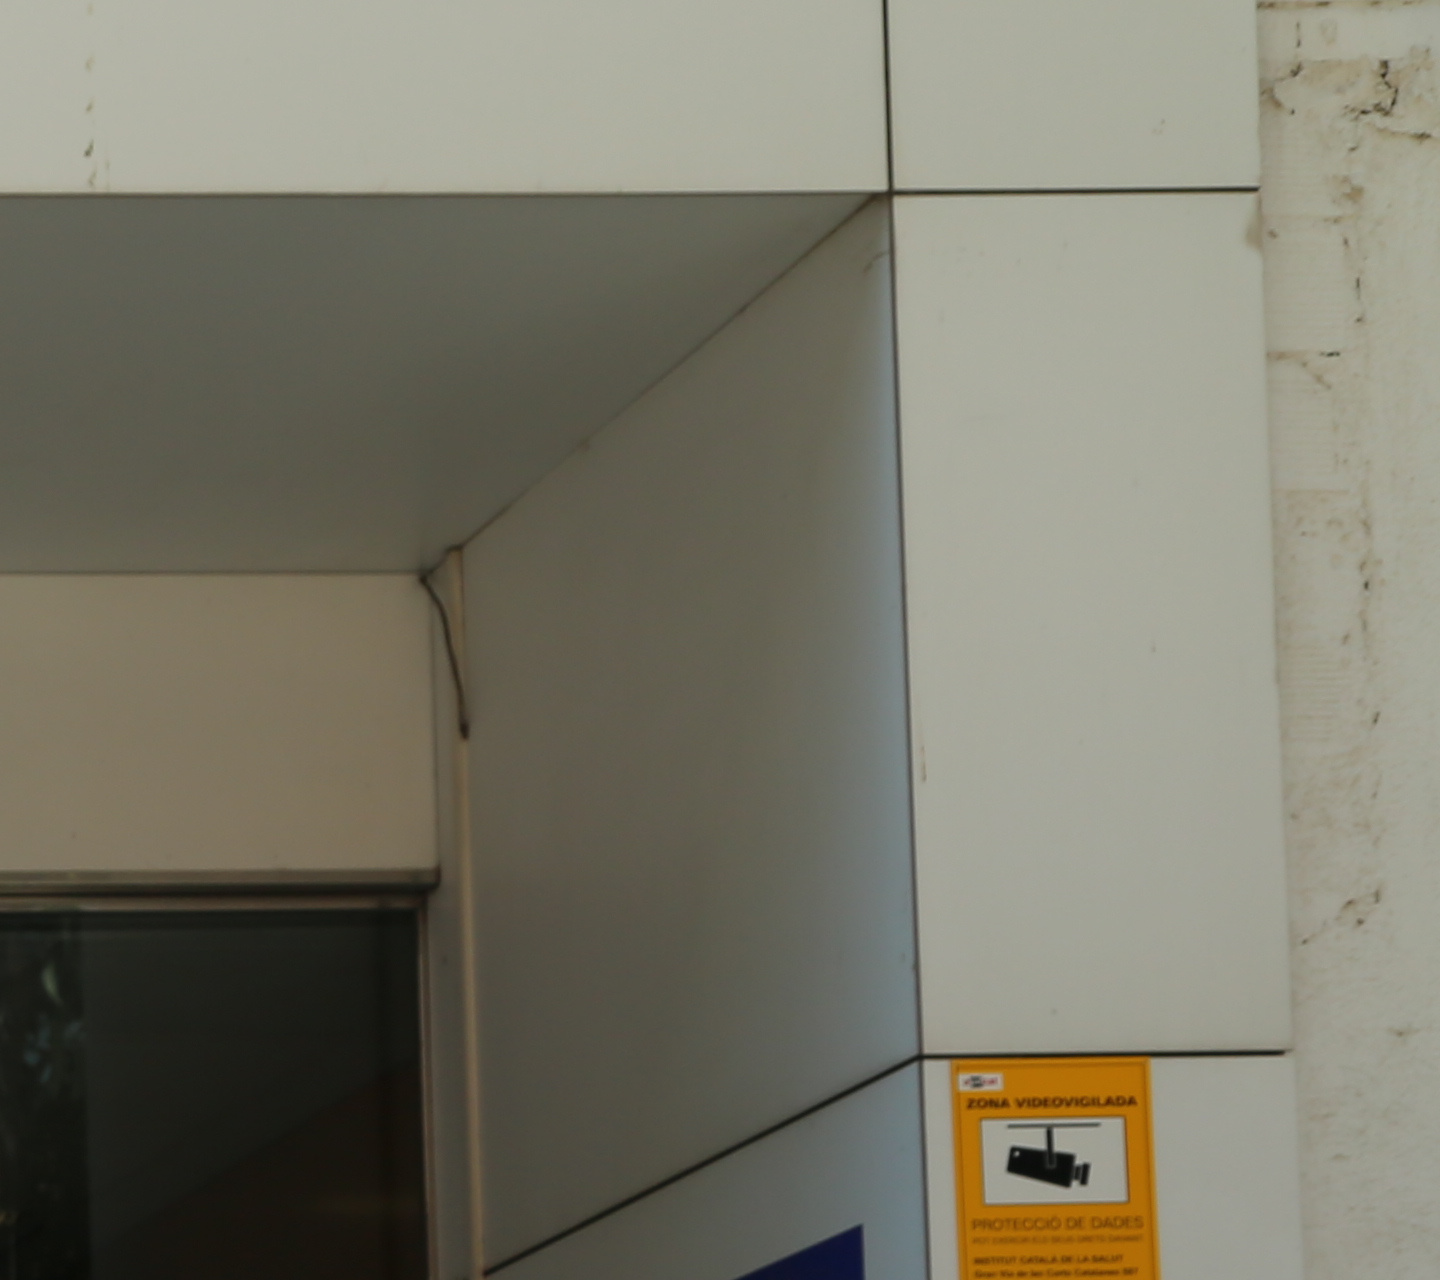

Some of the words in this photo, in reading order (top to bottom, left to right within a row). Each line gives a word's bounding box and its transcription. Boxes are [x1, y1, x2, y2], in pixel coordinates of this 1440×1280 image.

[967, 1098, 1011, 1110] ZONA
[1016, 1095, 1139, 1109] VIDEOVIGILADA
[1067, 1217, 1084, 1229] DE
[1092, 1216, 1144, 1230] DADES
